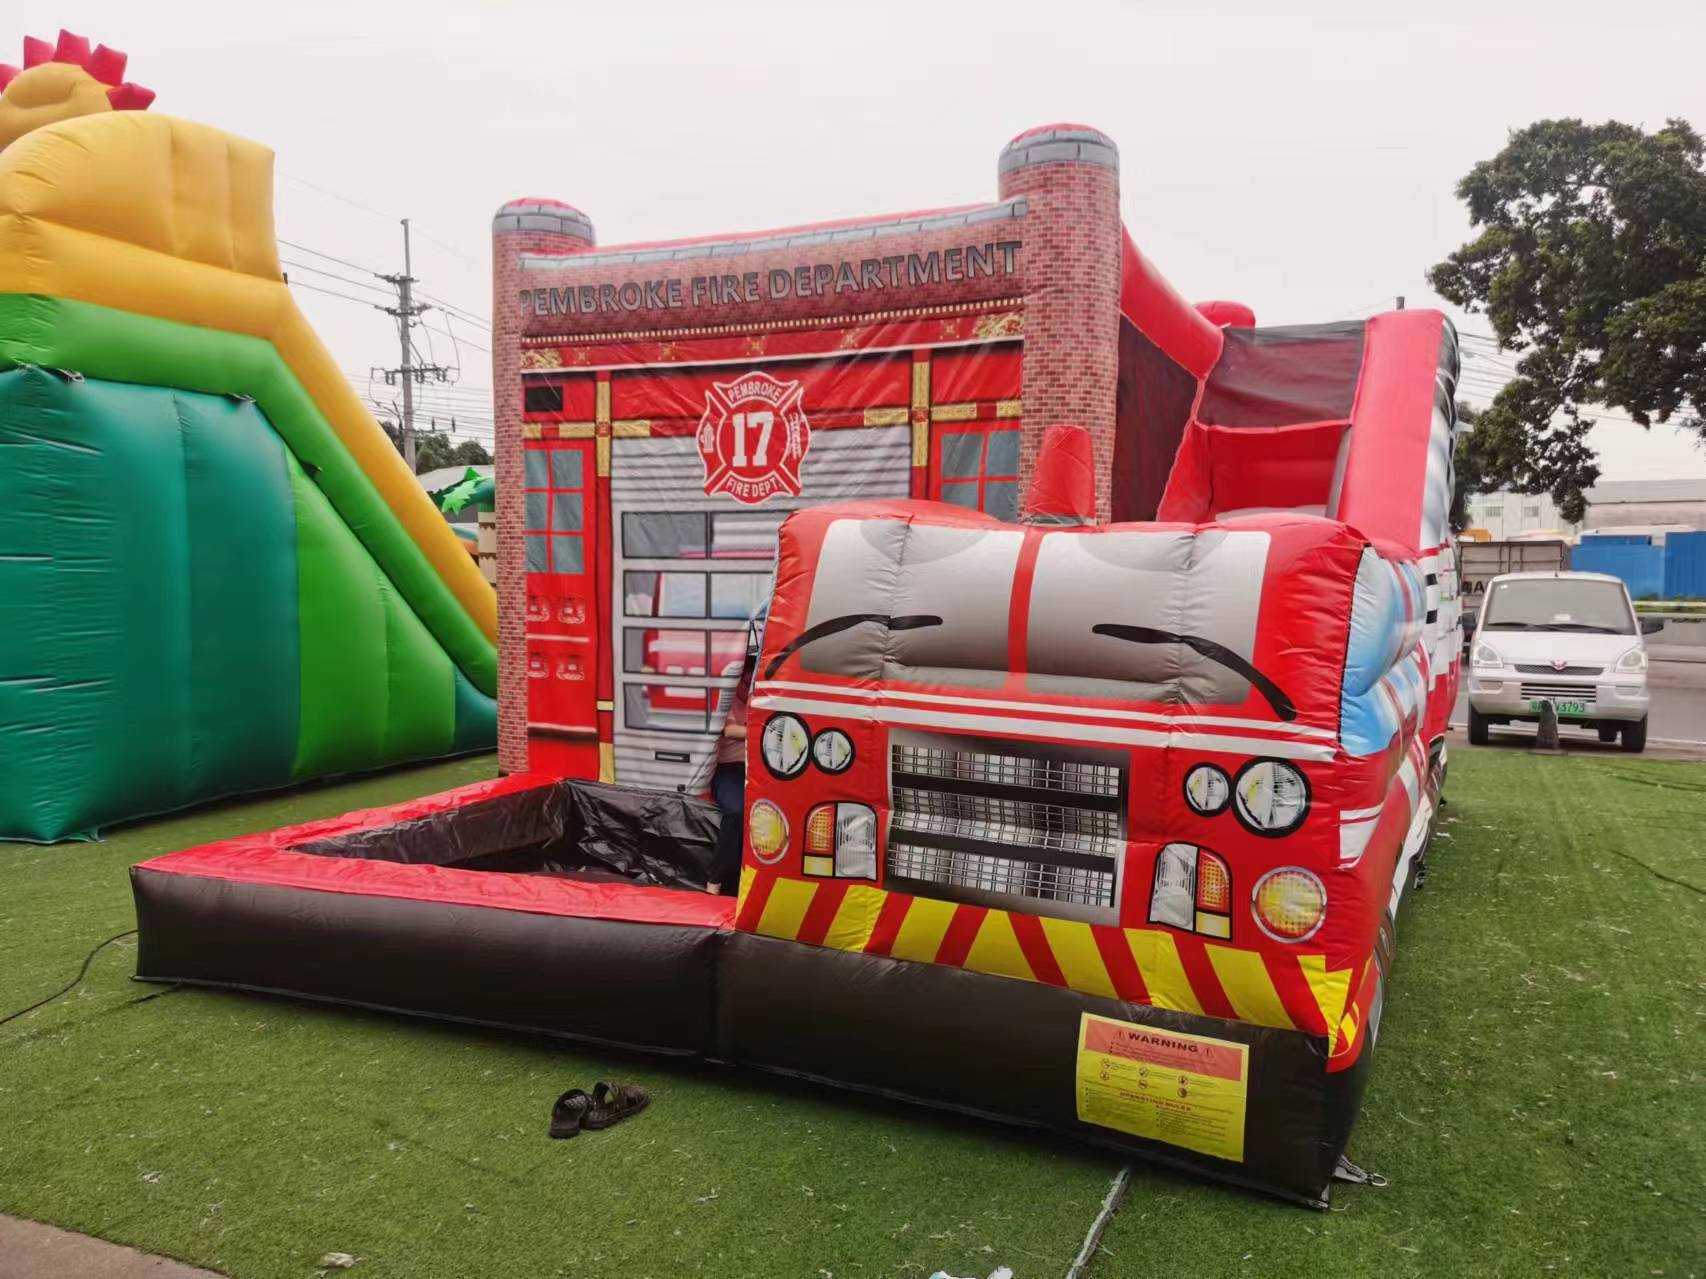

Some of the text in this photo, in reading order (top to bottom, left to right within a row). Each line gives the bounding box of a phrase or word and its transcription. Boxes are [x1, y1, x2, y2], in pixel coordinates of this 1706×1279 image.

[518, 240, 1024, 317] PEMBROKE FIRE DEPARTMENT
[727, 381, 784, 402] PEMBROKE
[732, 411, 775, 468] 17
[725, 477, 750, 497] FIRE
[1128, 1031, 1199, 1053] WARNING
